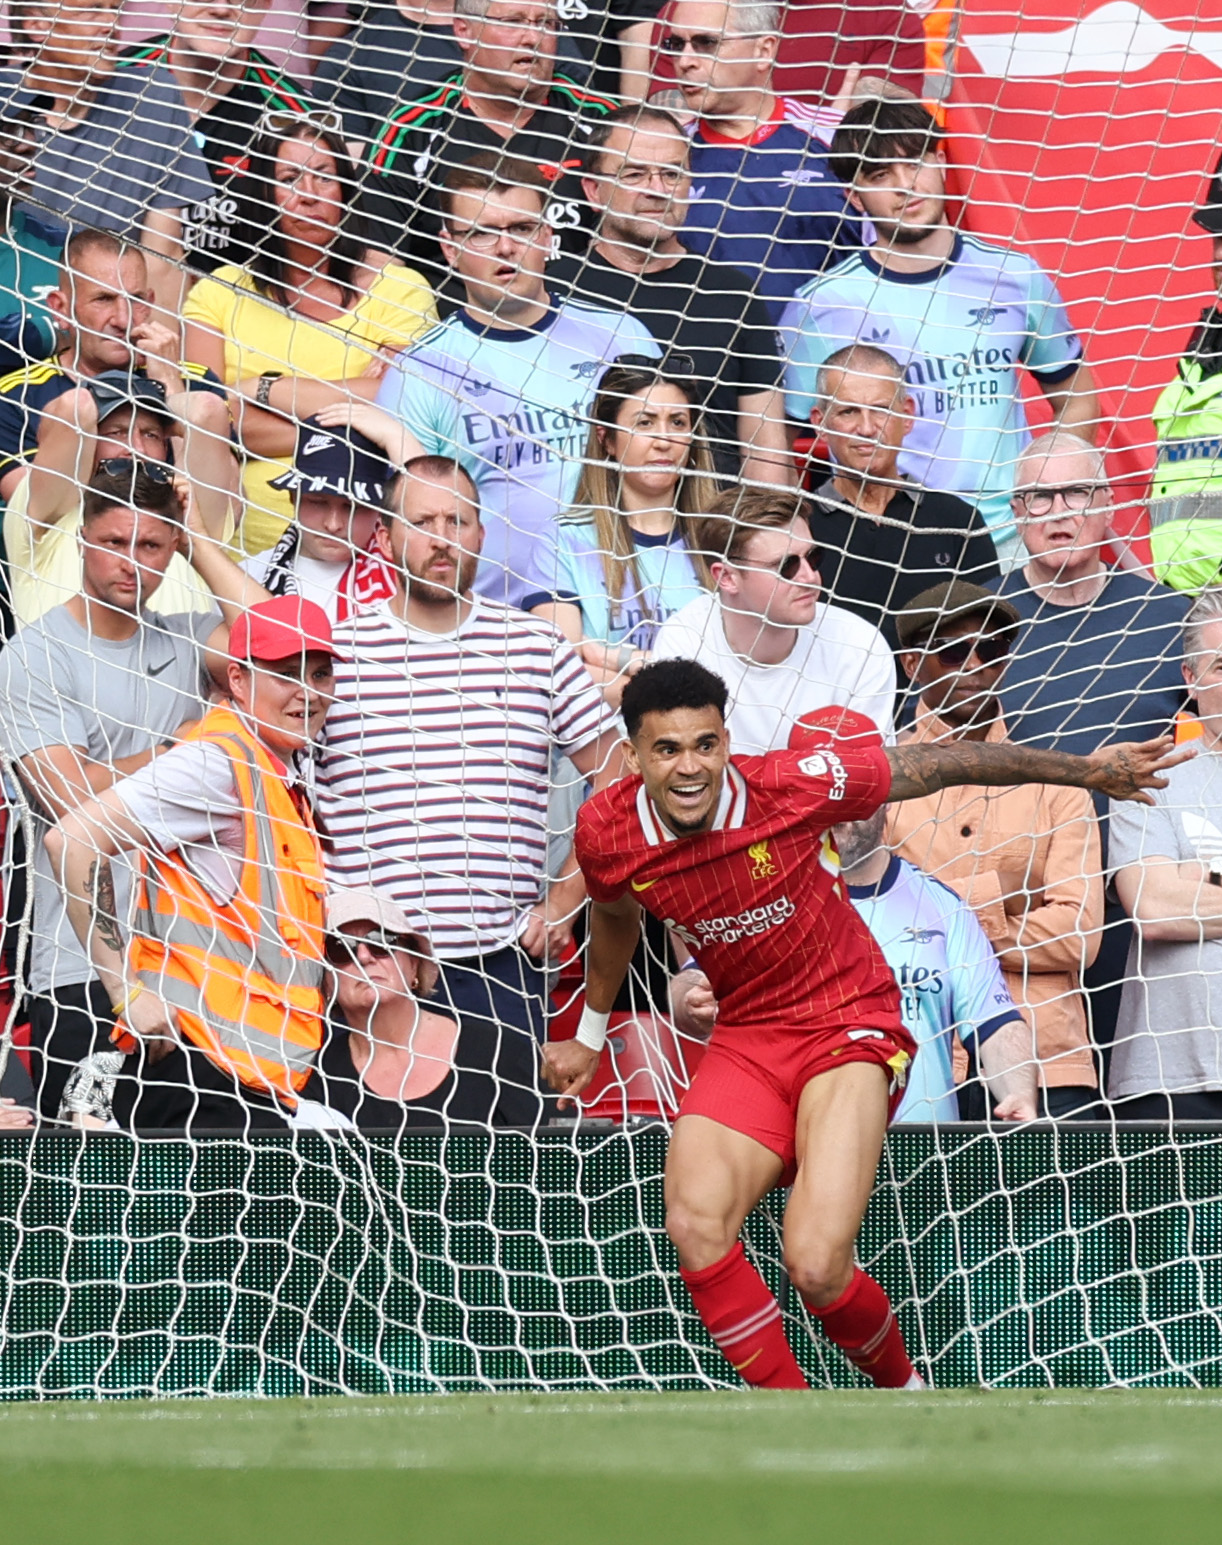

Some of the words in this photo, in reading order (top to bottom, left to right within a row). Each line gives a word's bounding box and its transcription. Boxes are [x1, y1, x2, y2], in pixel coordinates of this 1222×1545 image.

[934, 380, 999, 414] BETTER
[532, 432, 588, 466] BETTE
[751, 864, 779, 881] LFC
[694, 895, 790, 934] standard
